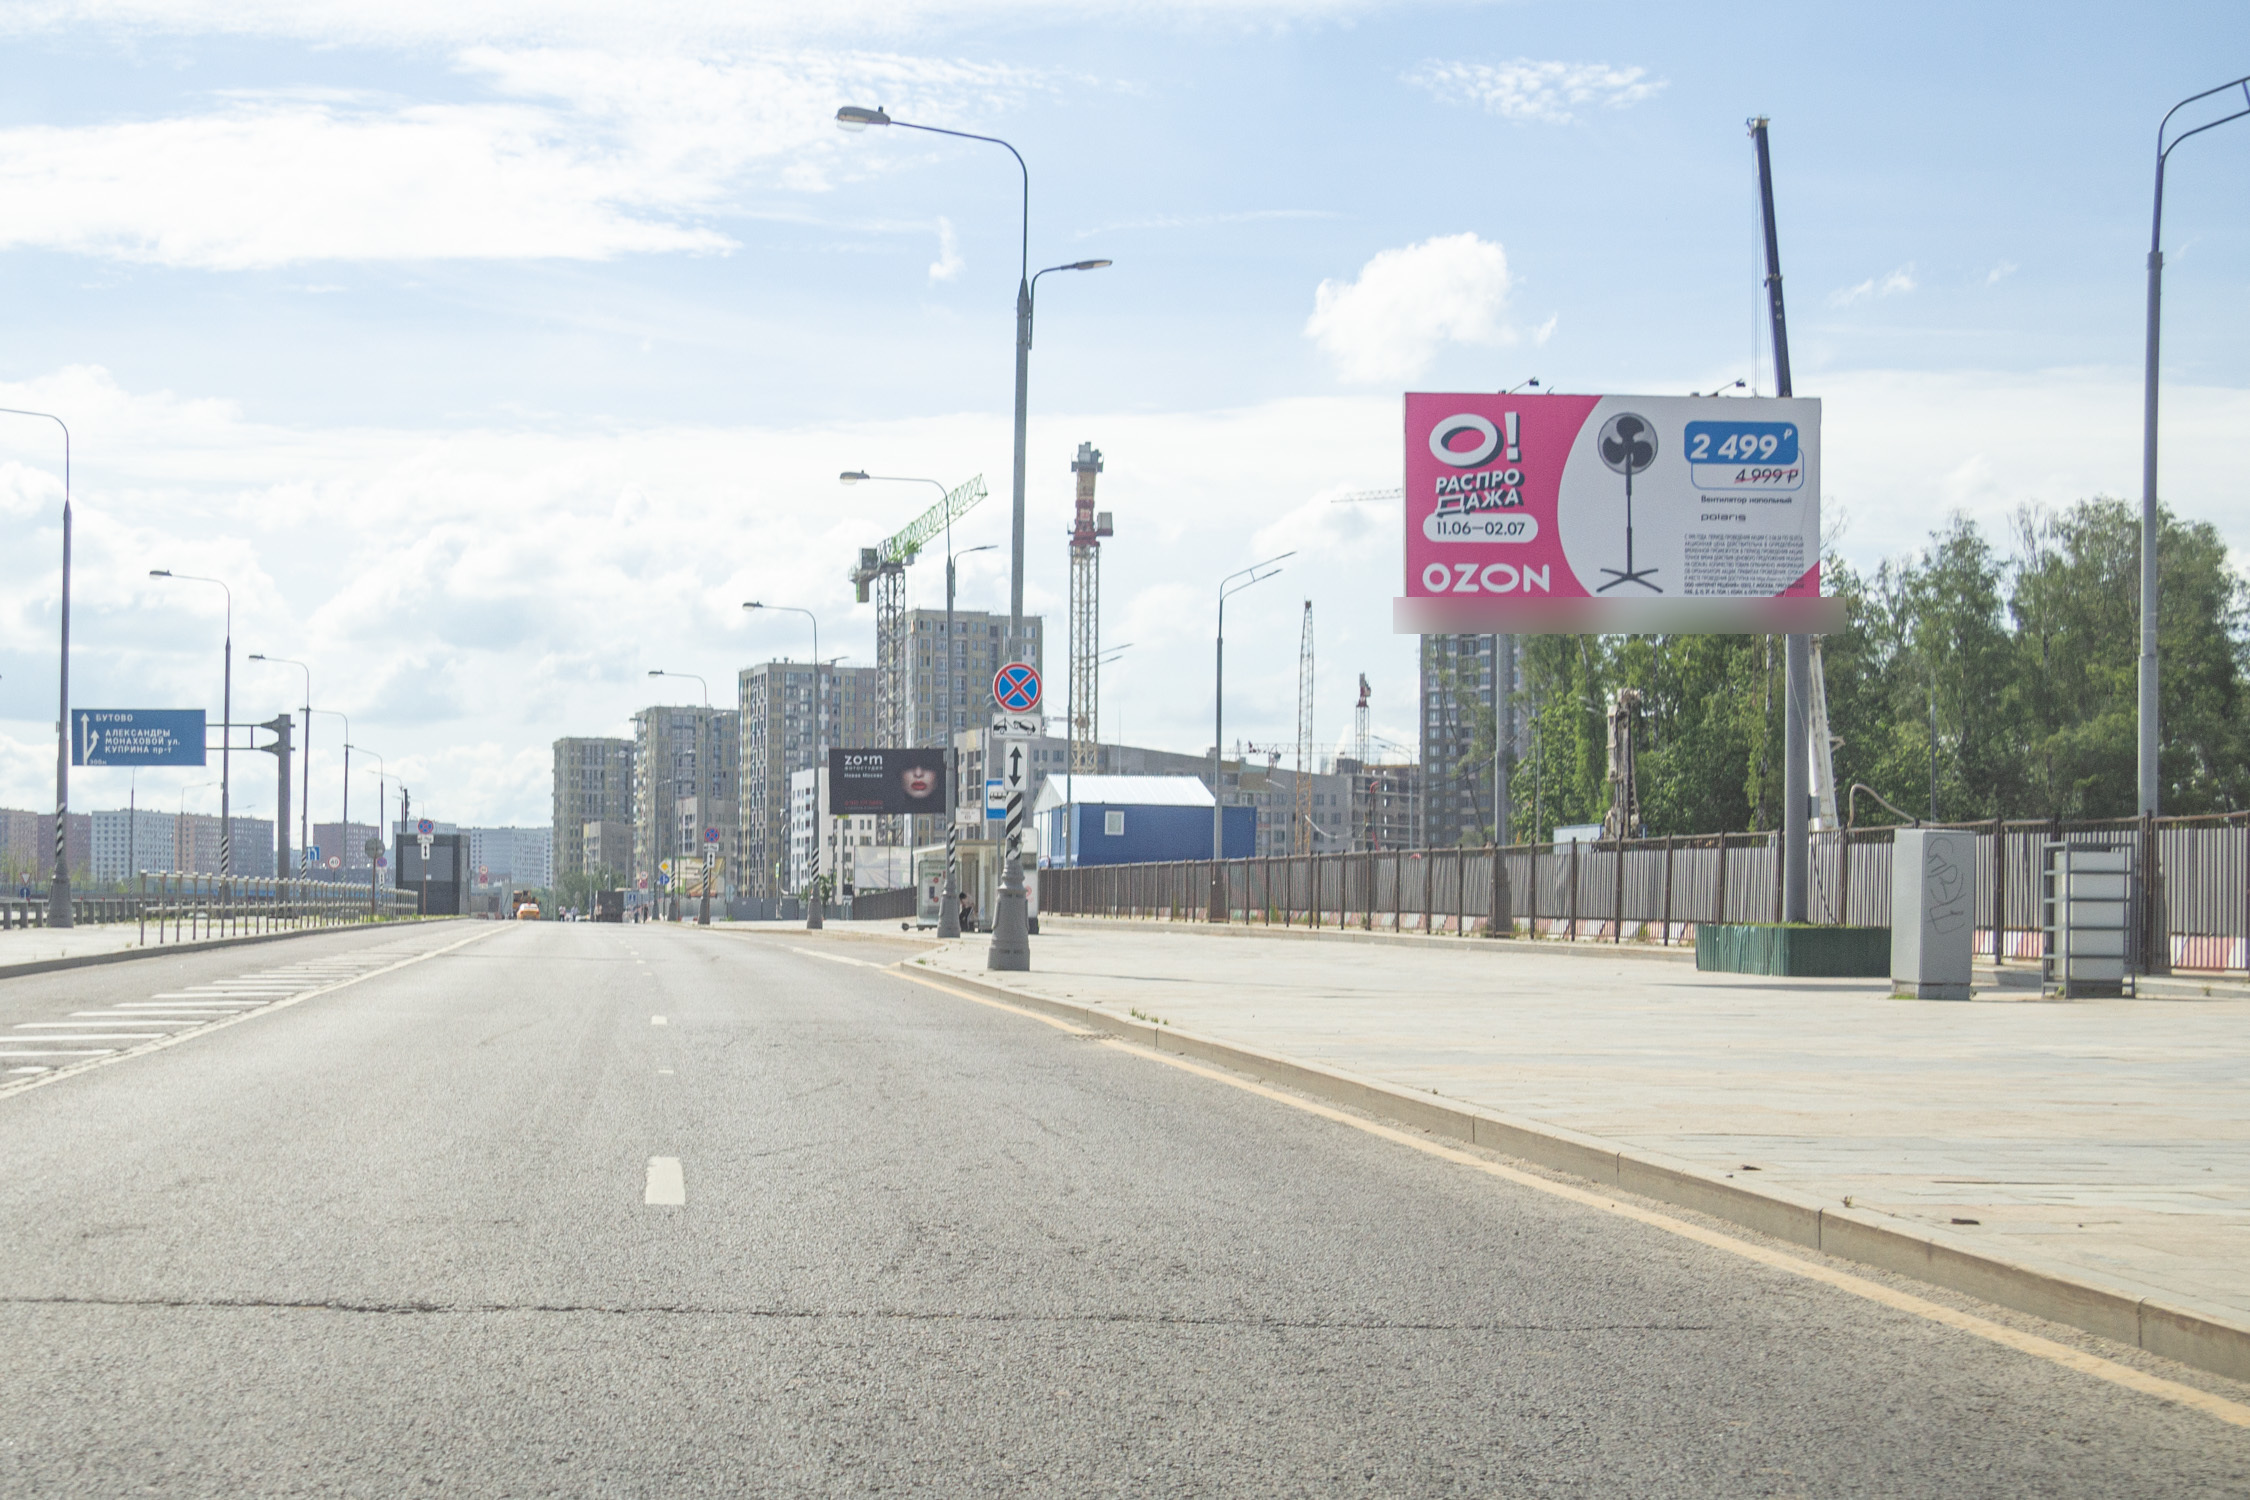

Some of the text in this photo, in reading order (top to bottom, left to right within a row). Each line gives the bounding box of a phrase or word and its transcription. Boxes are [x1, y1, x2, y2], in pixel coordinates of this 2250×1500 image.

[1690, 433, 1711, 460] 2
[1718, 433, 1778, 460] 499
[1735, 468, 1746, 483] 4
[1751, 468, 1783, 484] 999
[1435, 468, 1525, 495] РАСПРО
[1434, 487, 1524, 518] ДАЖА
[1701, 495, 1747, 505] Вентилятор
[1701, 513, 1746, 522] polaris
[1422, 562, 1550, 593] OZON
[96, 714, 133, 722] БУТОВО
[105, 729, 170, 737] АЛЕКСАНДРЫ
[105, 737, 164, 746] МОНАХОВОЙ
[105, 746, 149, 754] КУПРИНА
